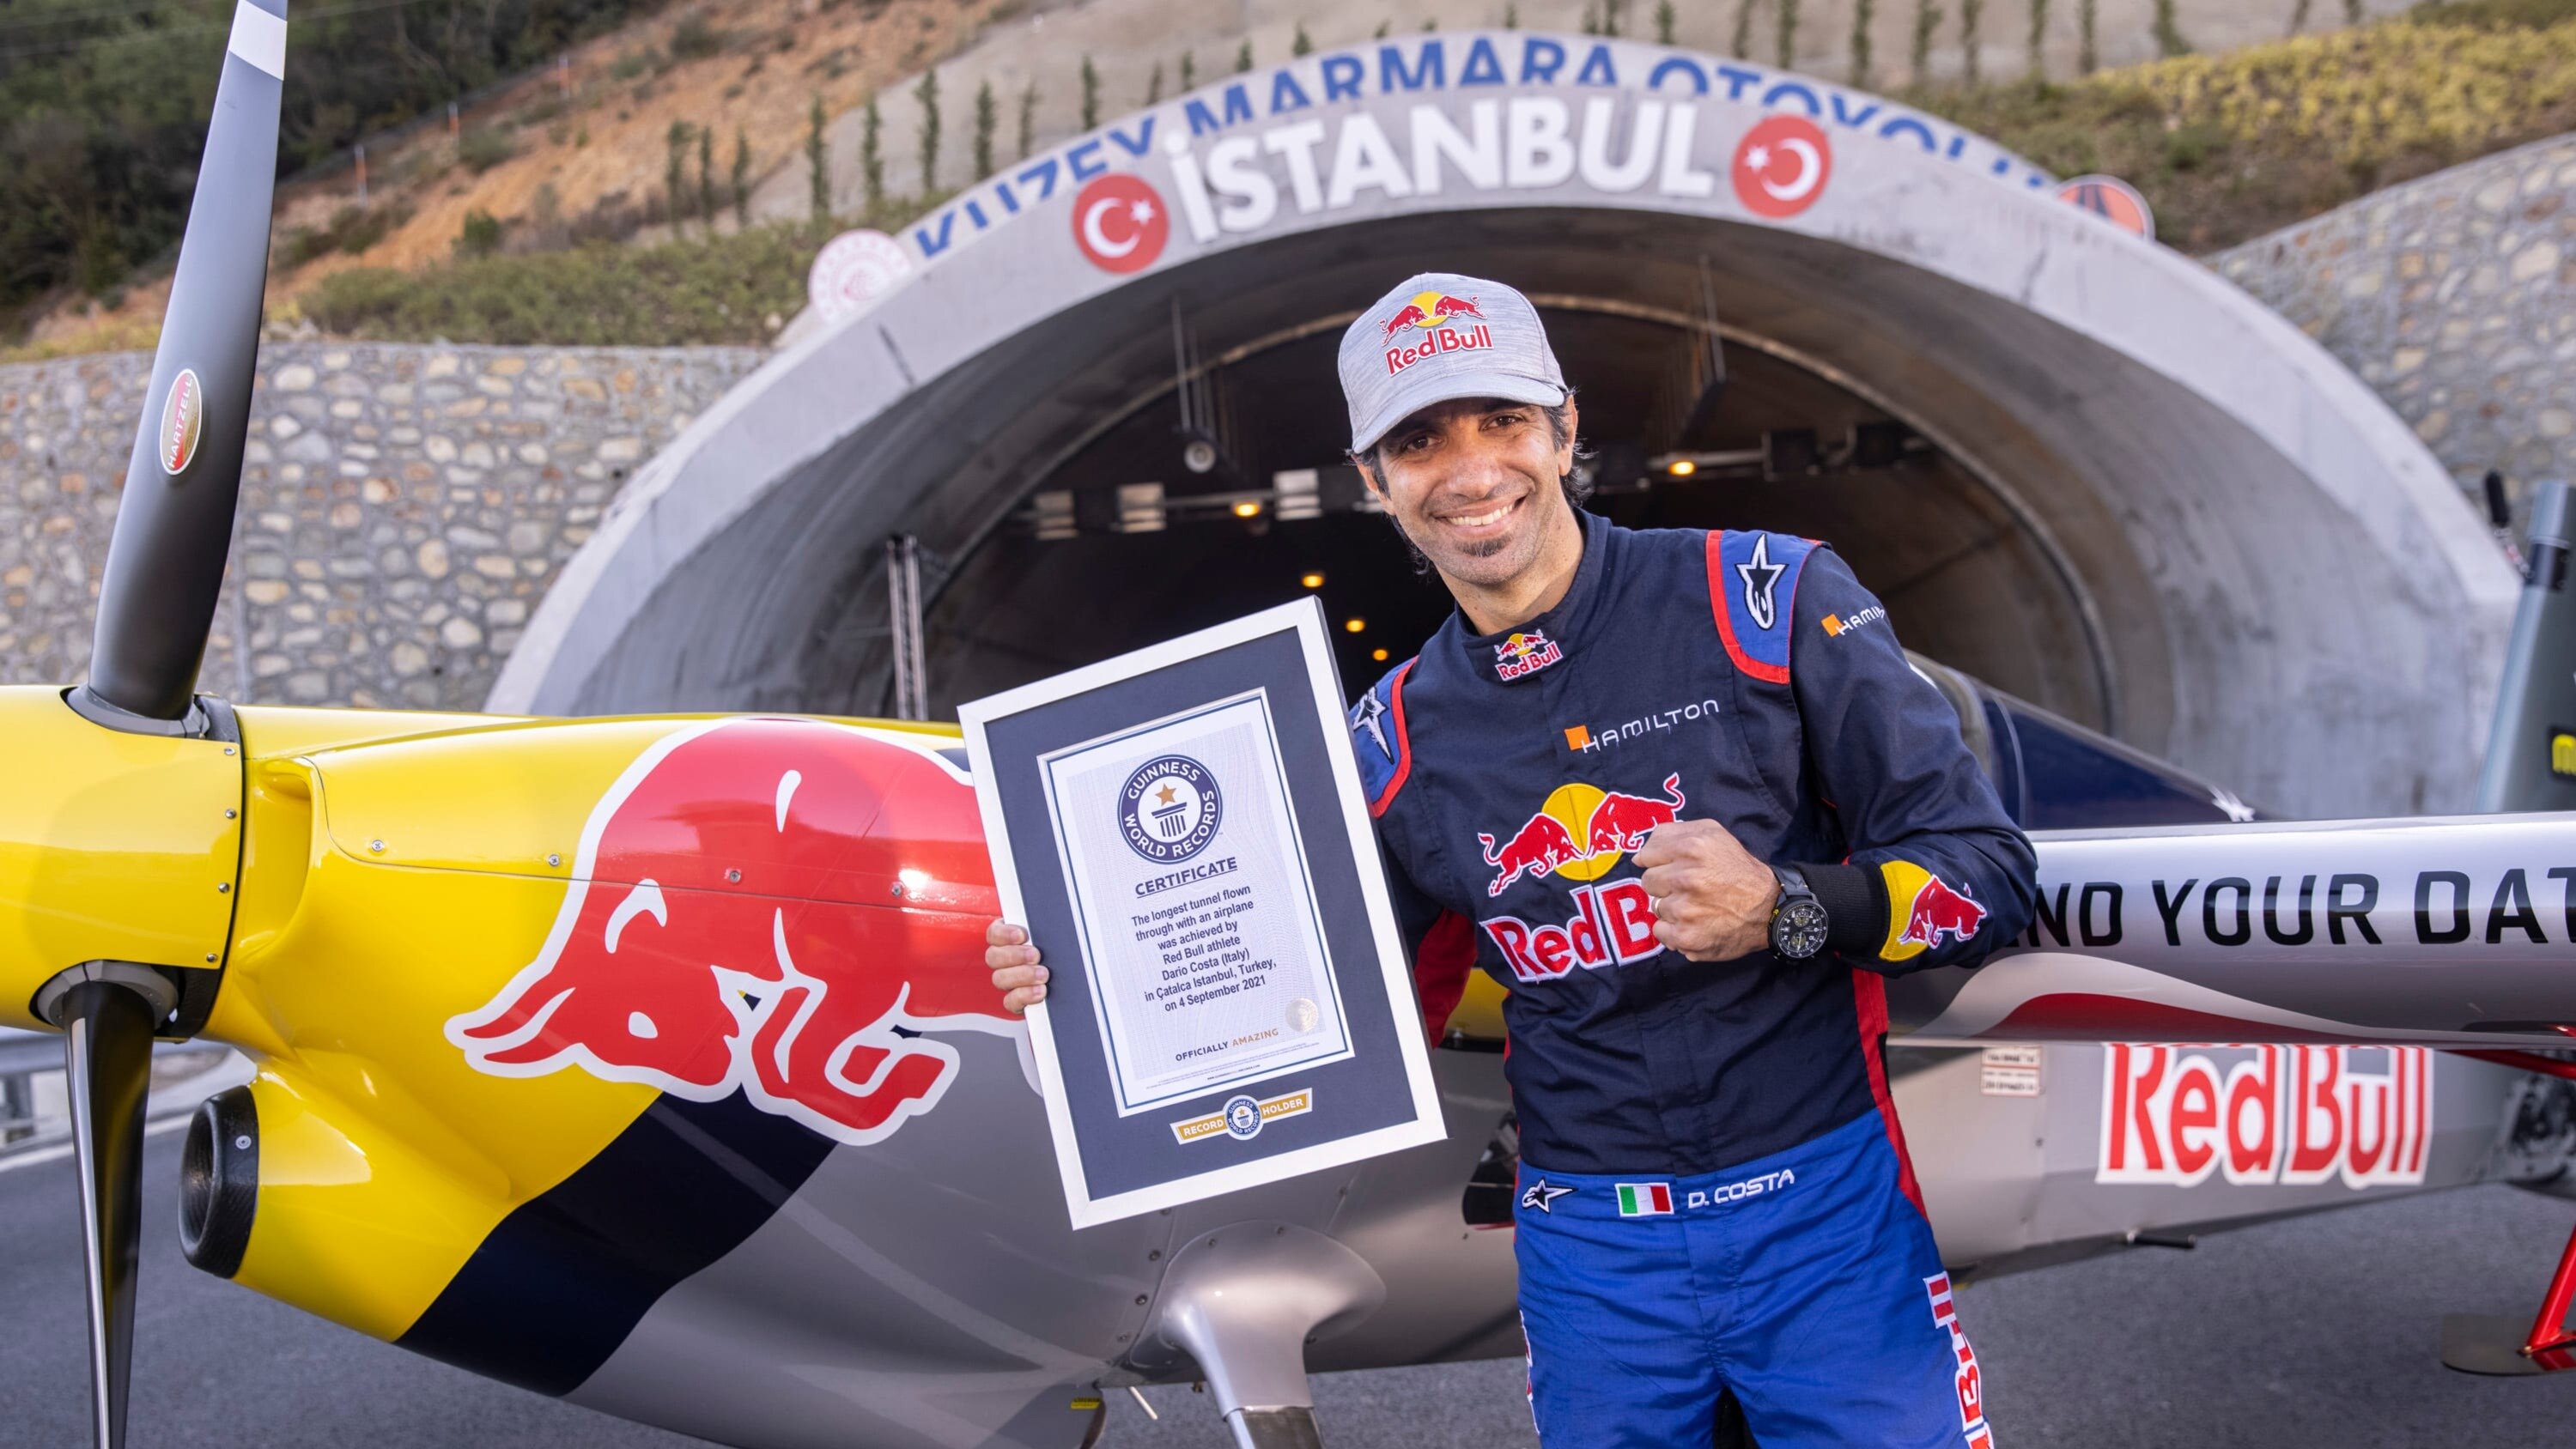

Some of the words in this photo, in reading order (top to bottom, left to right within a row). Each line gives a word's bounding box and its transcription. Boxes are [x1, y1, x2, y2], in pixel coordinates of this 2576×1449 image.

[1184, 37, 1619, 136] MARMARA
[1164, 96, 1716, 243] İSTANBUL
[1385, 329, 1437, 376] Red
[1437, 324, 1493, 353] Bull
[167, 376, 193, 470] HARTZELL
[1496, 655, 1528, 681] Red
[1528, 640, 1563, 670] Bull
[1580, 699, 1719, 754] HAMILTON
[1127, 761, 1200, 799] GUINNESS
[1124, 813, 1166, 858] WORLD
[1172, 790, 1216, 858] RECORDS
[1135, 857, 1237, 898] CERTIFICATE
[1131, 916, 1150, 927] The
[1151, 902, 1188, 921] longest
[1189, 892, 1221, 910] tunnel
[1223, 885, 1251, 900] flown
[1135, 921, 1174, 942] through
[1176, 915, 1197, 930] with
[1199, 912, 1212, 924] an
[1213, 900, 1255, 919] airplane
[2005, 881, 2123, 948] ND
[2152, 872, 2383, 947] YOUR
[1157, 937, 1177, 950] was
[1179, 923, 1224, 945] achieved
[1224, 920, 1238, 933] by
[1163, 950, 1182, 965] Red
[1184, 944, 1205, 959] Bull
[1207, 936, 1241, 953] athlete
[1482, 887, 1611, 980] Red
[1145, 991, 1155, 1002] in
[1156, 981, 1192, 1001] Çatalca
[1193, 968, 1237, 988] Istanbul,
[1237, 957, 1277, 975] Turkey,
[1162, 966, 1188, 981] Dario
[1189, 957, 1219, 973] Costa
[1221, 947, 1250, 967] (Italy)
[1164, 1001, 1177, 1012] on
[1179, 997, 1186, 1009] 4
[1186, 983, 1240, 1006] September
[1242, 974, 1267, 991] 2021
[1175, 1041, 1229, 1062] OFFICIALLY
[1232, 1028, 1279, 1047] AMAZING
[1183, 1119, 1224, 1137] RECORD
[1261, 1098, 1304, 1116] HOLDER
[2105, 1044, 2278, 1175] Red
[2289, 1044, 2428, 1176] Bull
[1688, 1191, 1710, 1209] D.
[1714, 1168, 1795, 1204] COSTA
